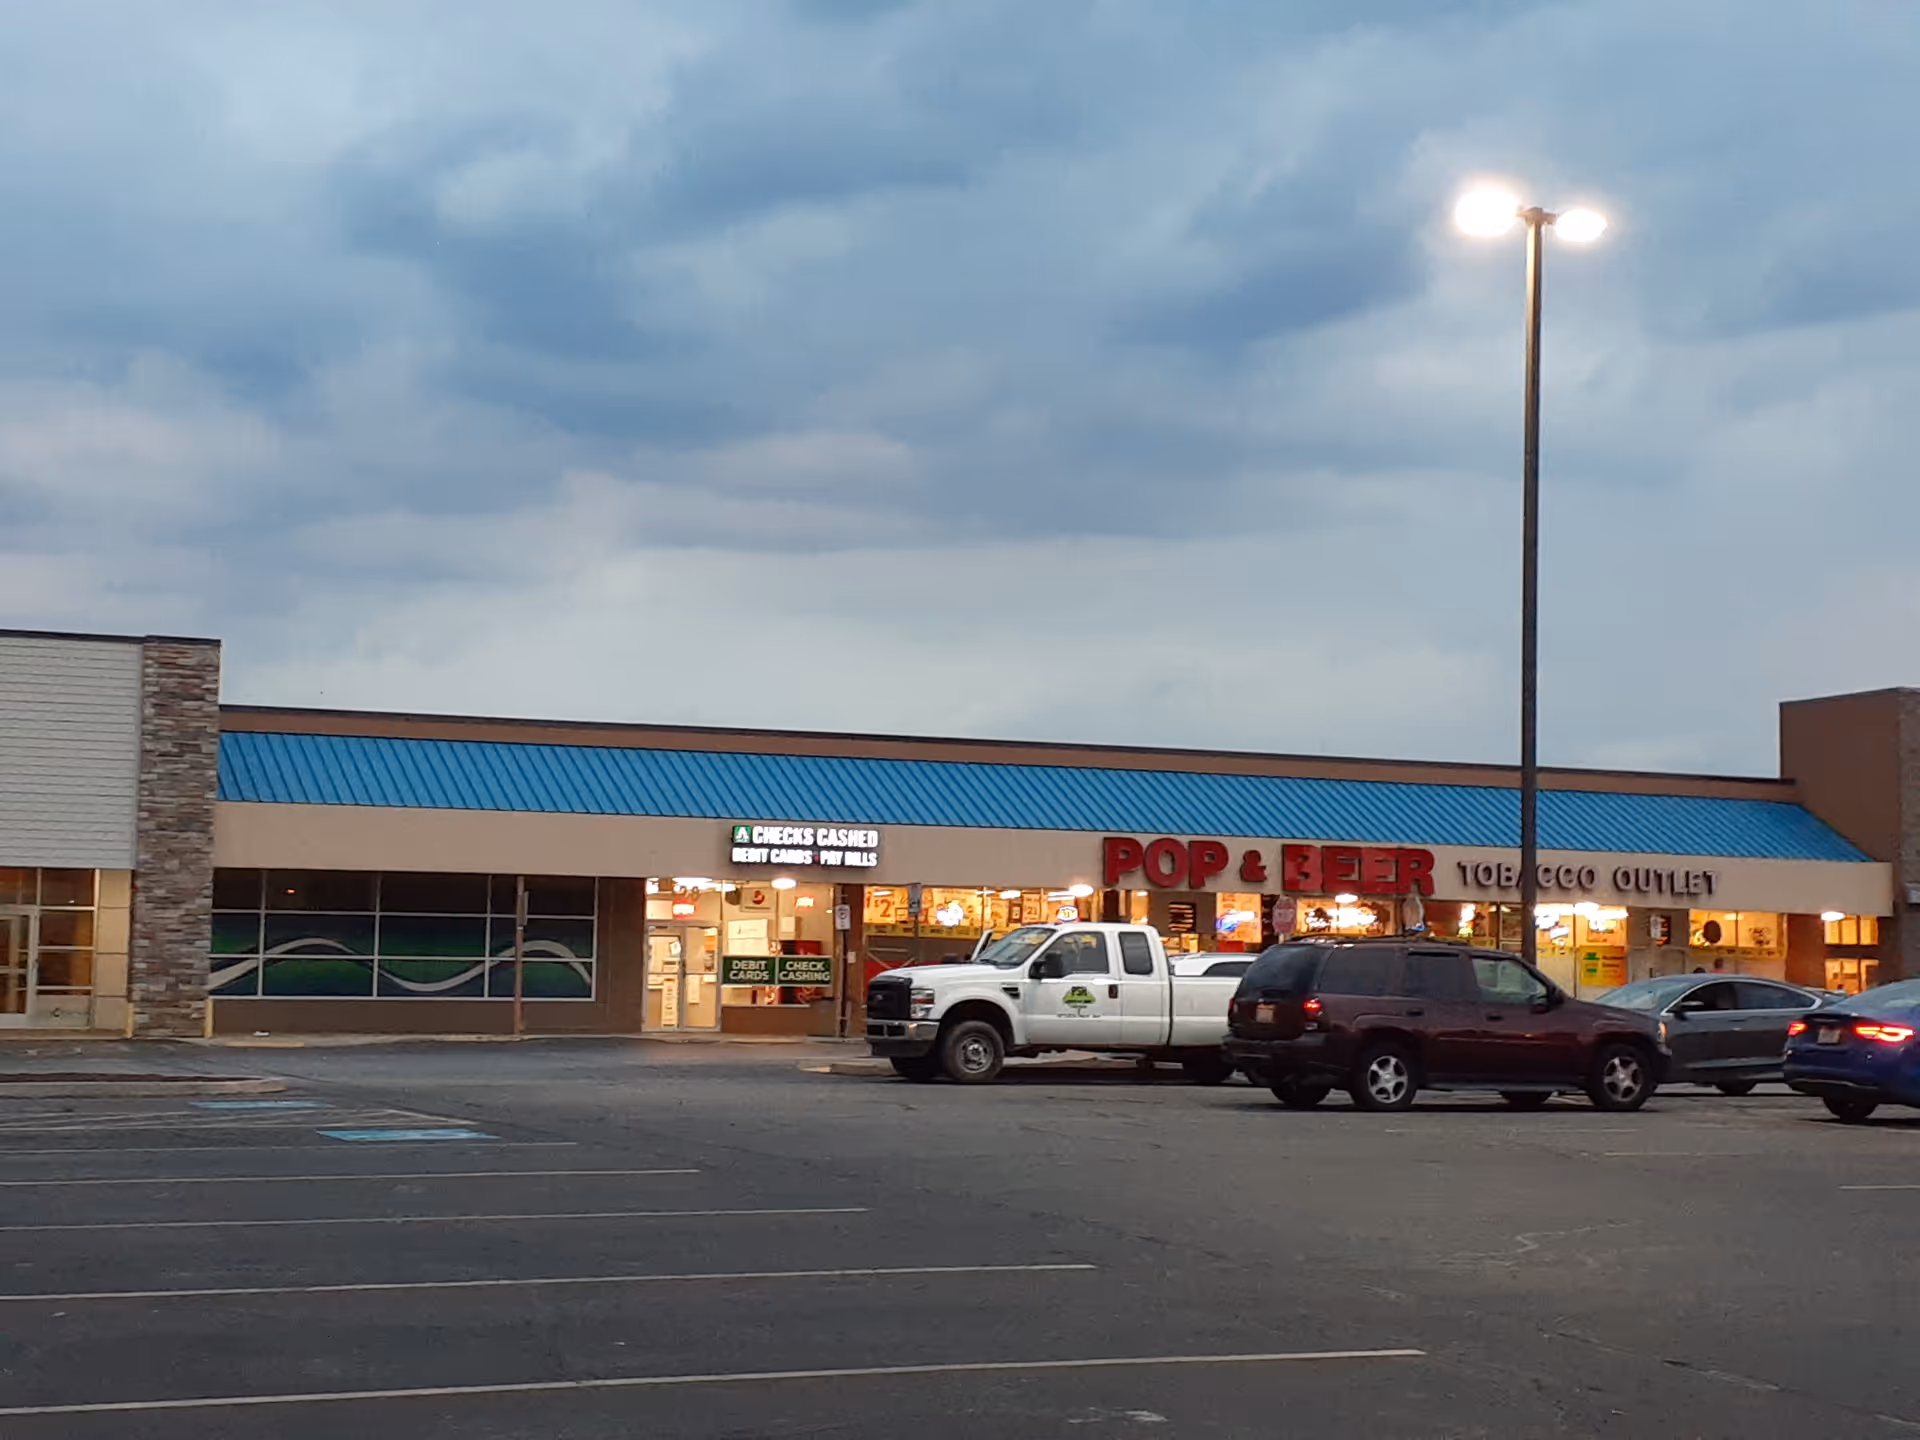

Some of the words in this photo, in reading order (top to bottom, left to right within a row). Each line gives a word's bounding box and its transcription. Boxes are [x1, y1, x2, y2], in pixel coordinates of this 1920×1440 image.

[752, 826, 814, 846] CHECKS
[817, 828, 878, 848] CASHED
[820, 850, 843, 866] PAY
[1103, 837, 1229, 890] POP
[1240, 849, 1268, 883] &
[1282, 844, 1435, 896] BEER
[1613, 866, 1718, 896] OUTLET
[732, 960, 767, 970] DEBIT
[785, 961, 825, 971] CHECK
[729, 970, 770, 981] CARDS
[779, 971, 831, 981] CASHING
